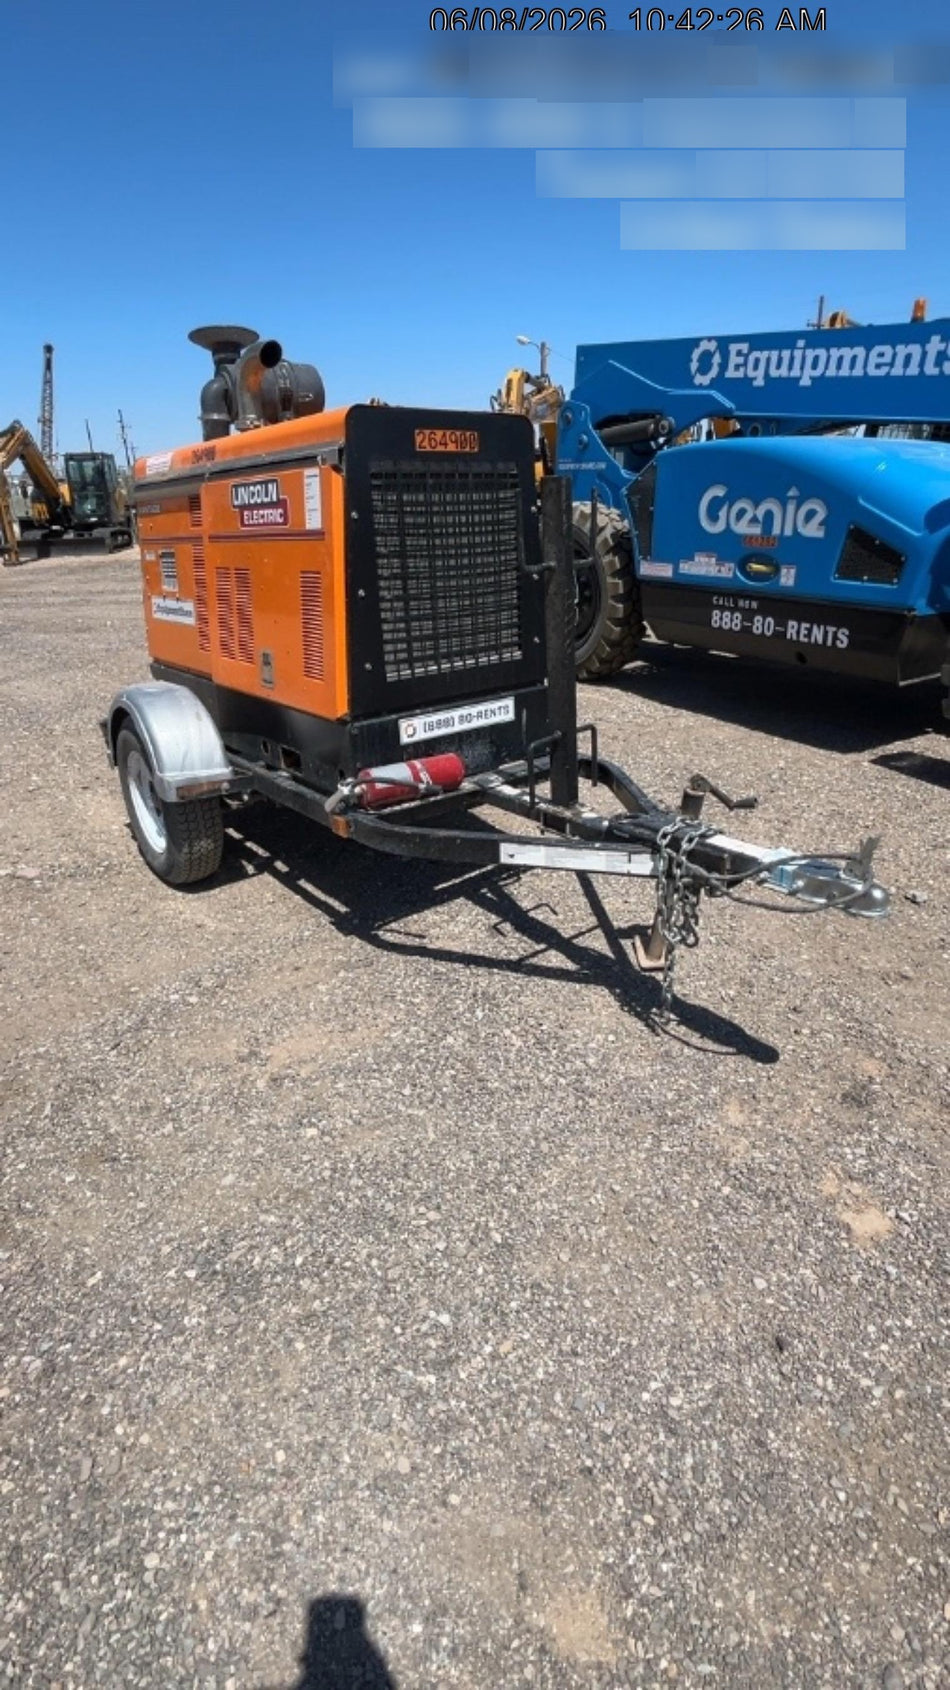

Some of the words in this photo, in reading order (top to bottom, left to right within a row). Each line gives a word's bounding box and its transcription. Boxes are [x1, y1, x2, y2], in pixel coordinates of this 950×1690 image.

[417, 431, 477, 450] 264900
[232, 481, 277, 506] LINCOLN
[243, 508, 284, 525] ELECTRIC
[698, 484, 828, 538] Genie
[713, 596, 735, 608] CALL
[738, 599, 759, 611] NOW
[711, 609, 849, 648] 888-80-RENTS
[423, 716, 455, 733] (888)
[457, 704, 510, 725] 80-RENTS
